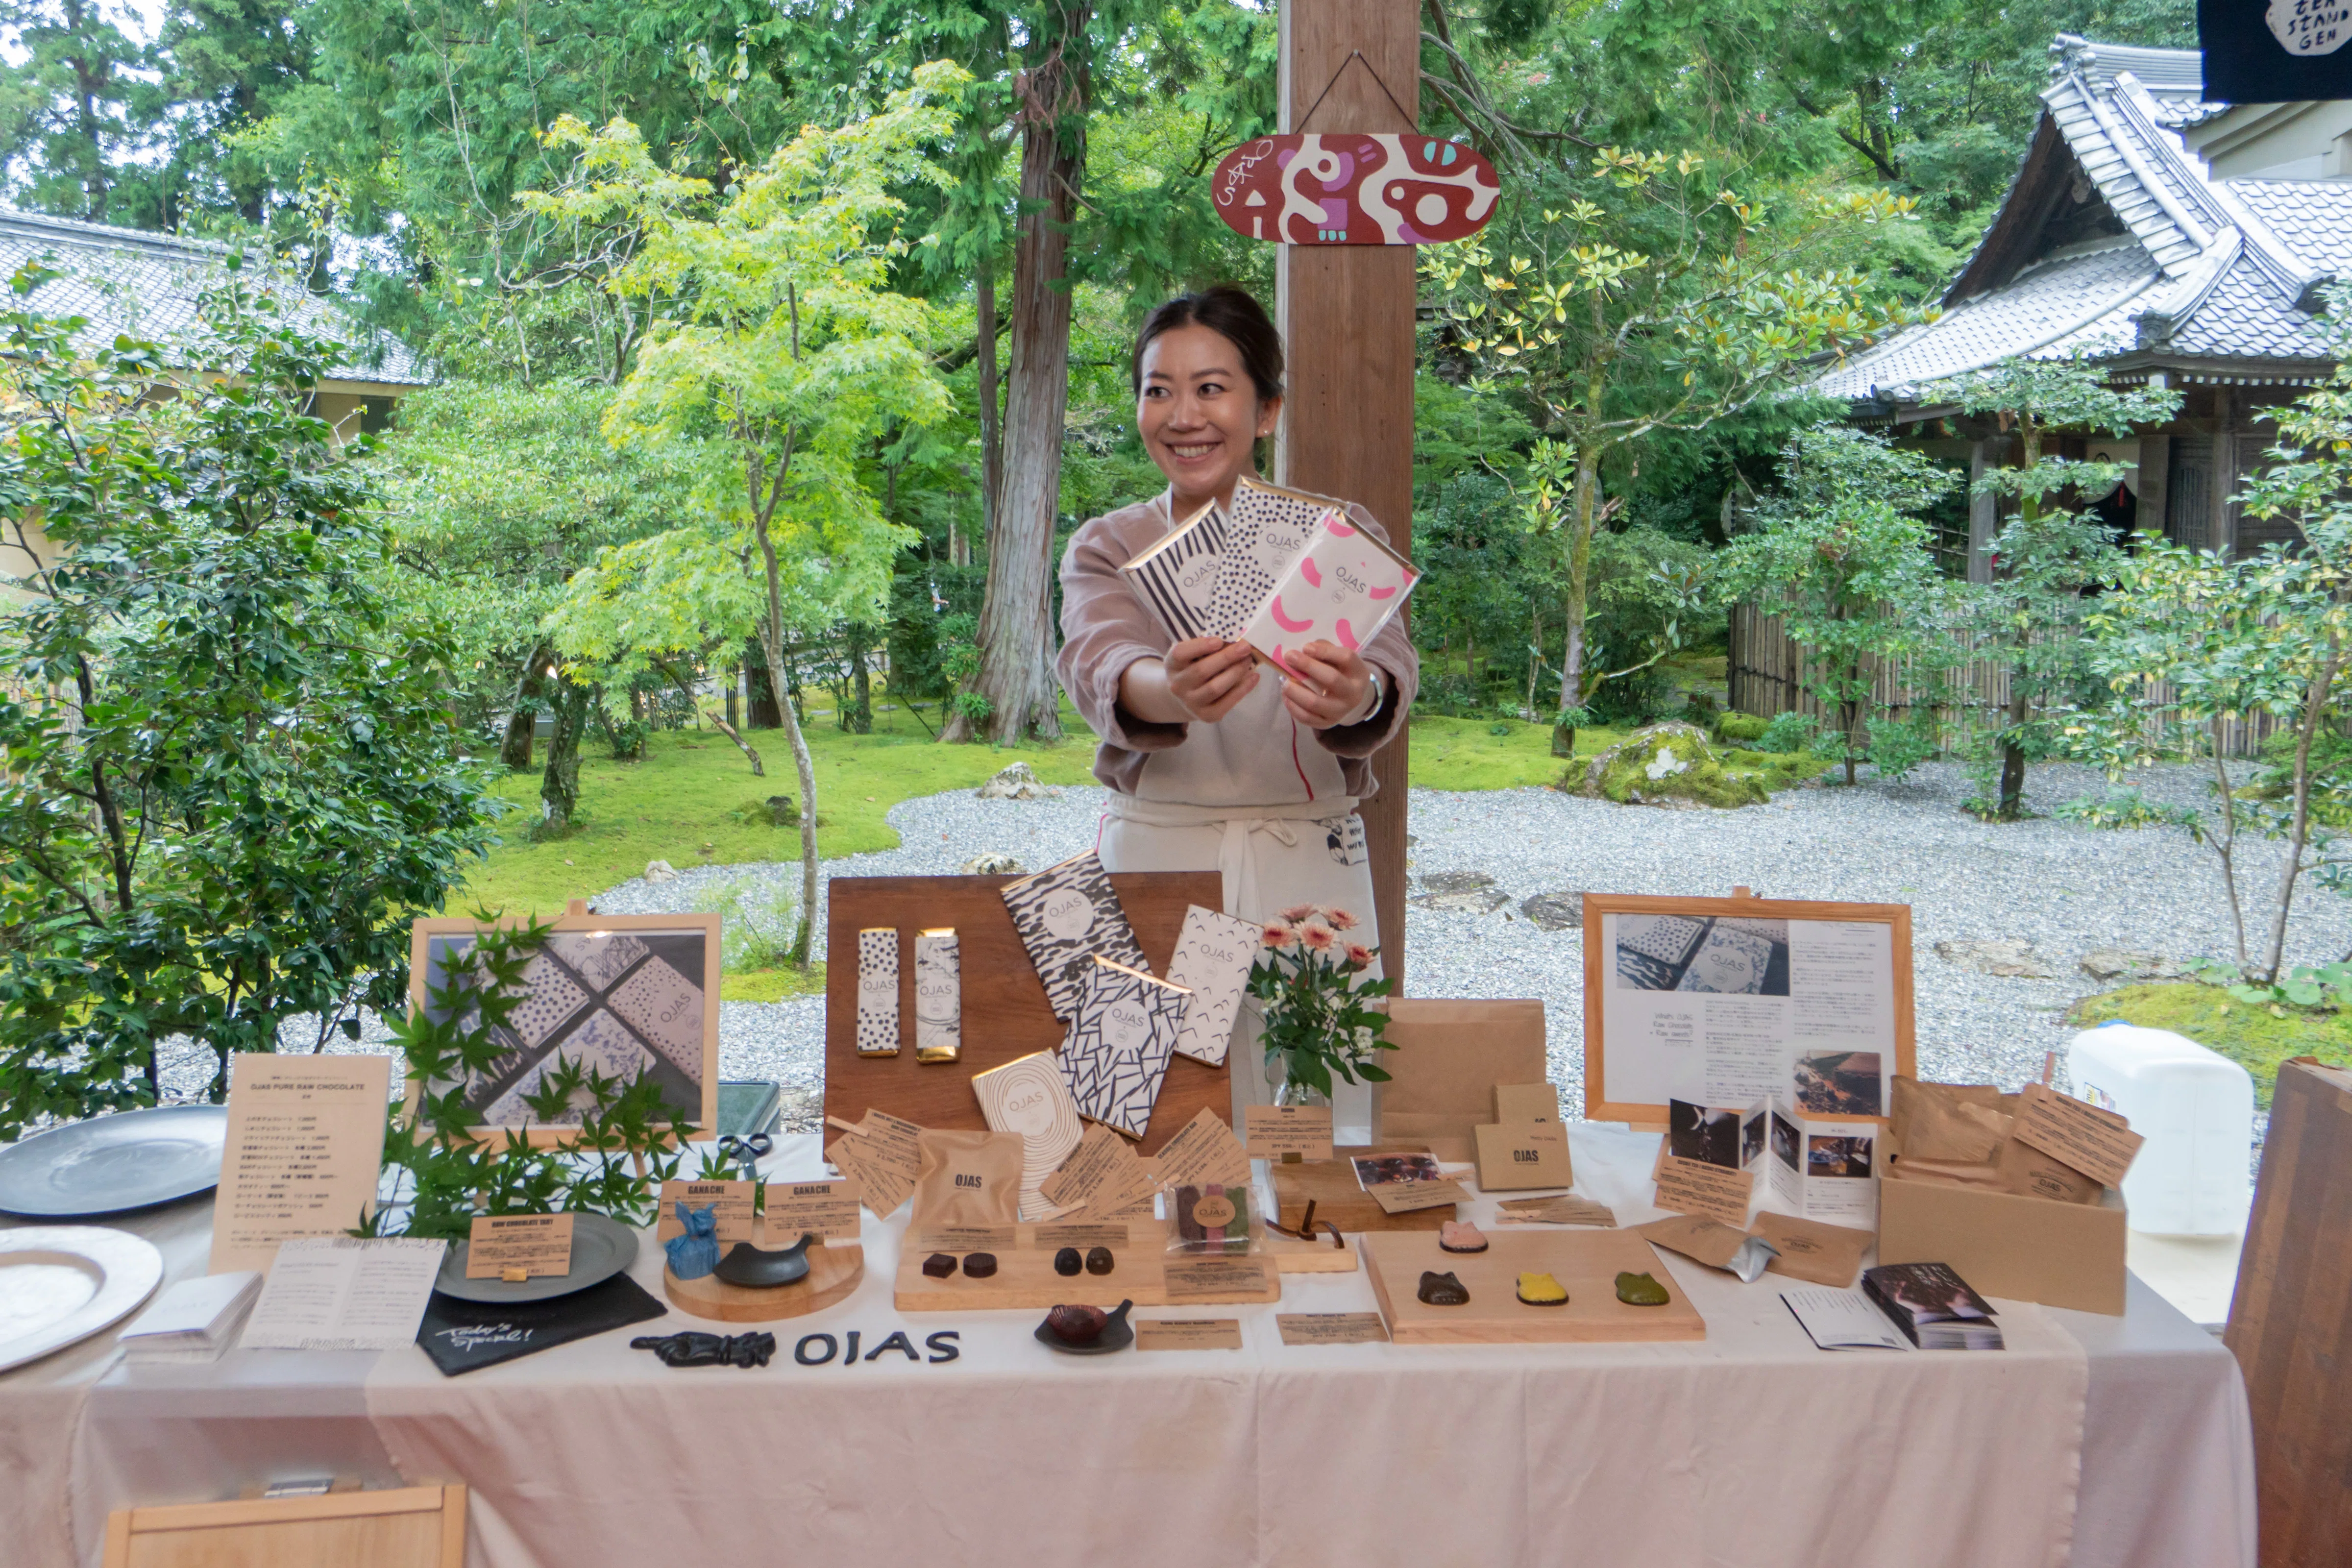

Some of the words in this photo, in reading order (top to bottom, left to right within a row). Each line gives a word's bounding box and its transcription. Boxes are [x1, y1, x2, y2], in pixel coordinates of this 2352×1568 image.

[2300, 29, 2336, 49] GEN
[1266, 532, 1301, 551] OJAS
[1183, 560, 1216, 588] OJAS
[1336, 566, 1366, 594] OJAS
[1049, 897, 1082, 918] OJAS
[1200, 944, 1234, 963] OJAS
[1711, 954, 1745, 971] OJAS
[863, 980, 895, 991] OJAS
[920, 985, 952, 996] OJAS
[661, 993, 691, 1023] OJAS
[1111, 1007, 1144, 1028] OJAS
[1009, 1092, 1044, 1113] OJAS
[1514, 1150, 1539, 1162] OJAS
[688, 1185, 725, 1194] GANACHE
[794, 1185, 830, 1195] GANACHE
[956, 1174, 982, 1188] OJAS
[435, 1323, 512, 1337] Today's
[795, 1331, 960, 1366] OJAS
